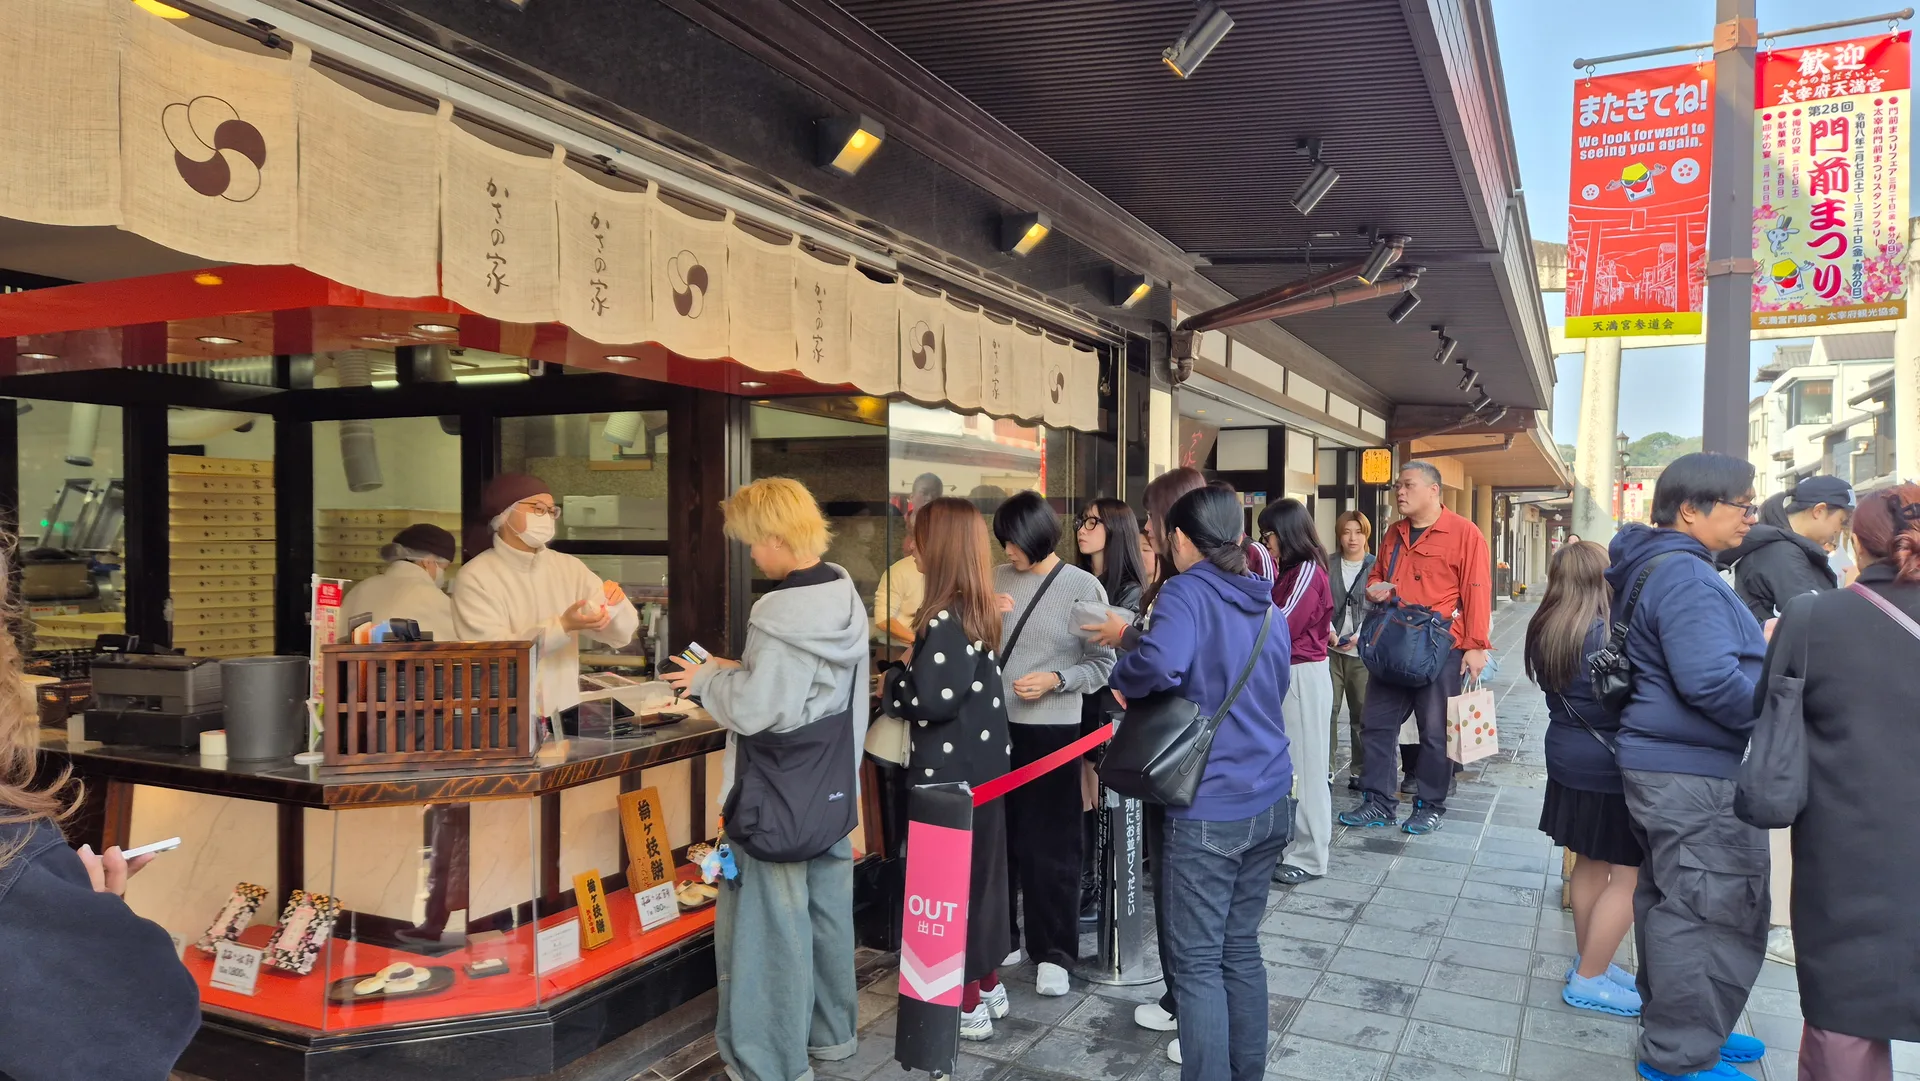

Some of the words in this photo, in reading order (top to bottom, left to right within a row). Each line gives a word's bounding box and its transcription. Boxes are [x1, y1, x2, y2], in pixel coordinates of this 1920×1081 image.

[1797, 43, 1867, 77] 歓迎
[1579, 79, 1708, 127] またきてね!
[1778, 76, 1885, 105] 太宰府天満宮
[1807, 101, 1854, 117] 第28回
[1578, 135, 1599, 148] We
[1602, 130, 1631, 145] look
[1634, 123, 1688, 141] forward
[1692, 122, 1706, 135] to
[1579, 145, 1626, 160] seeing
[1630, 141, 1655, 155] you
[1658, 136, 1703, 151] again.
[1806, 116, 1851, 299] 門前まつり
[486, 177, 509, 294] かさの家
[590, 212, 610, 316] かさの家
[812, 281, 826, 363] かさの家
[1592, 317, 1675, 332] 天満宮参道会
[908, 894, 958, 923] OUT
[917, 920, 945, 938] 出口
